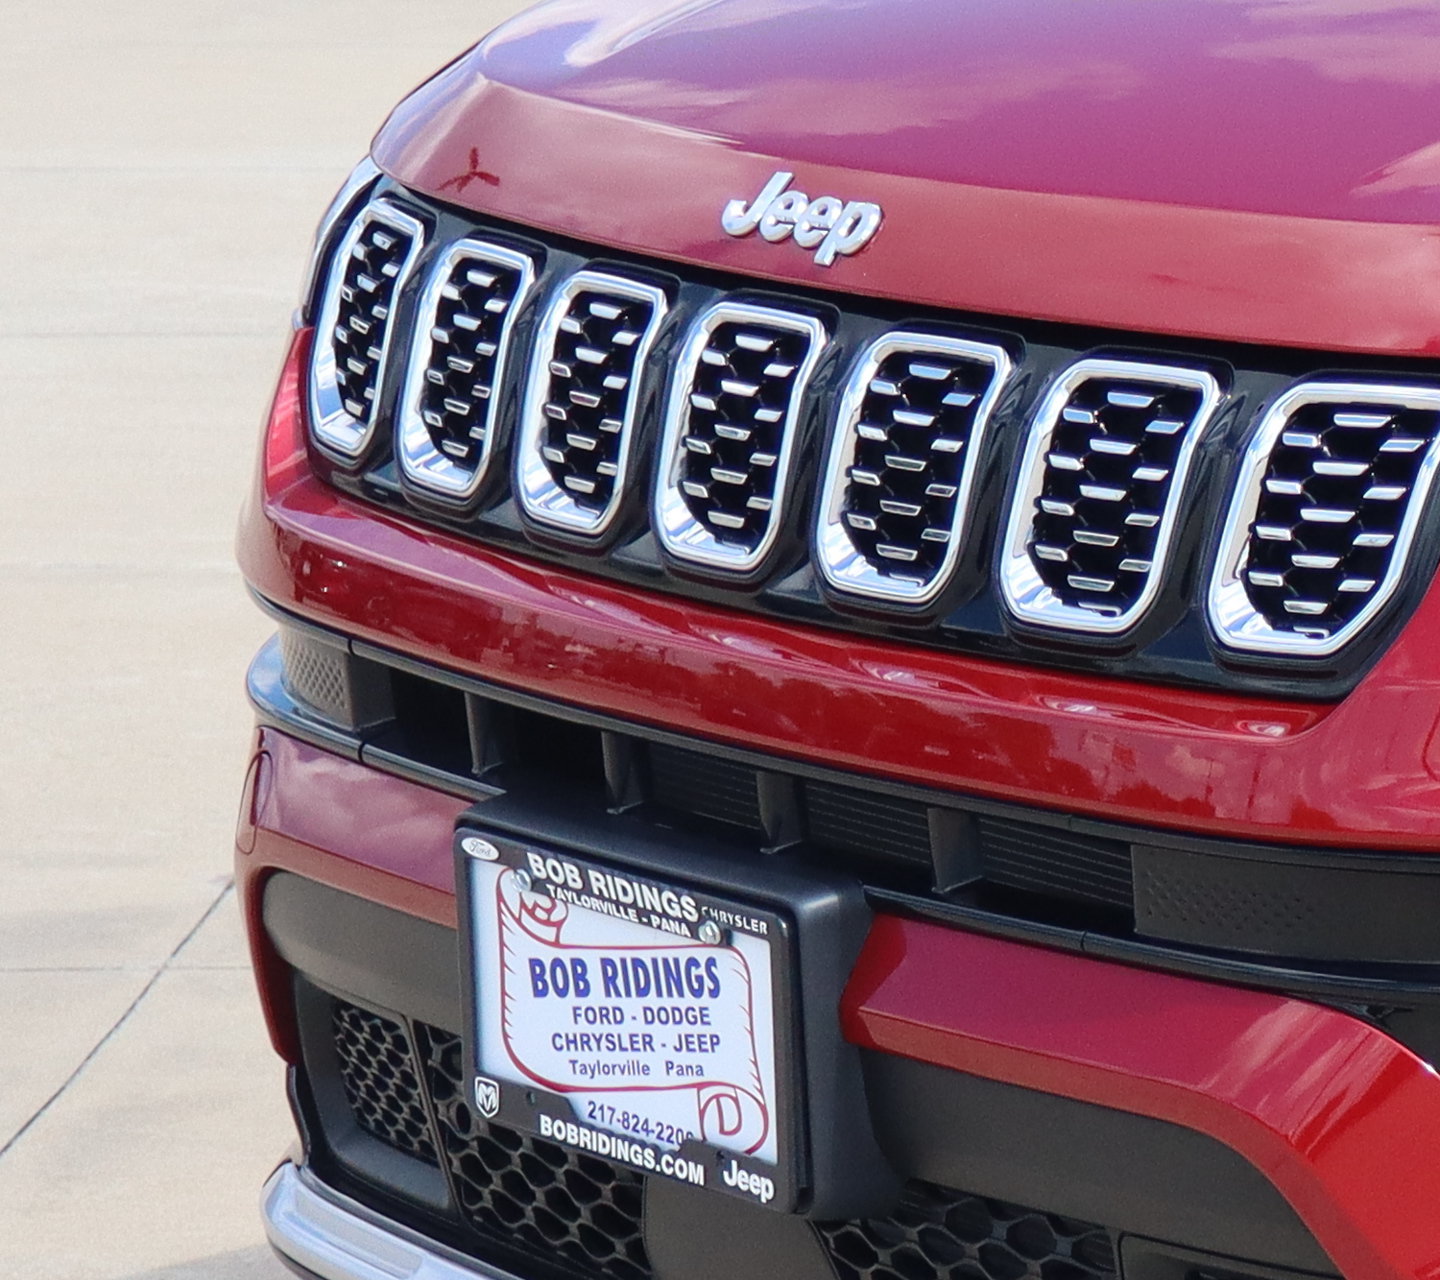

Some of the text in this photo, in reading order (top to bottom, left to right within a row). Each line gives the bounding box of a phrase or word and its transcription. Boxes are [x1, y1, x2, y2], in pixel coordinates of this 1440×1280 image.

[721, 171, 881, 267] Jeep
[527, 852, 699, 923] BOB RIDINGS
[546, 883, 640, 922] TAYLORVILLE
[651, 913, 692, 938] PANA
[528, 956, 721, 999] BOB RIDINGS
[572, 1006, 625, 1025] FORD
[642, 1006, 711, 1026] DODGE
[551, 1032, 655, 1053] CHRYSLER
[673, 1034, 721, 1053] JEEP
[569, 1059, 704, 1080] Taylorville Pana
[539, 1113, 705, 1187] BOBRIDINGS.COM
[722, 1159, 775, 1204] Jeep
